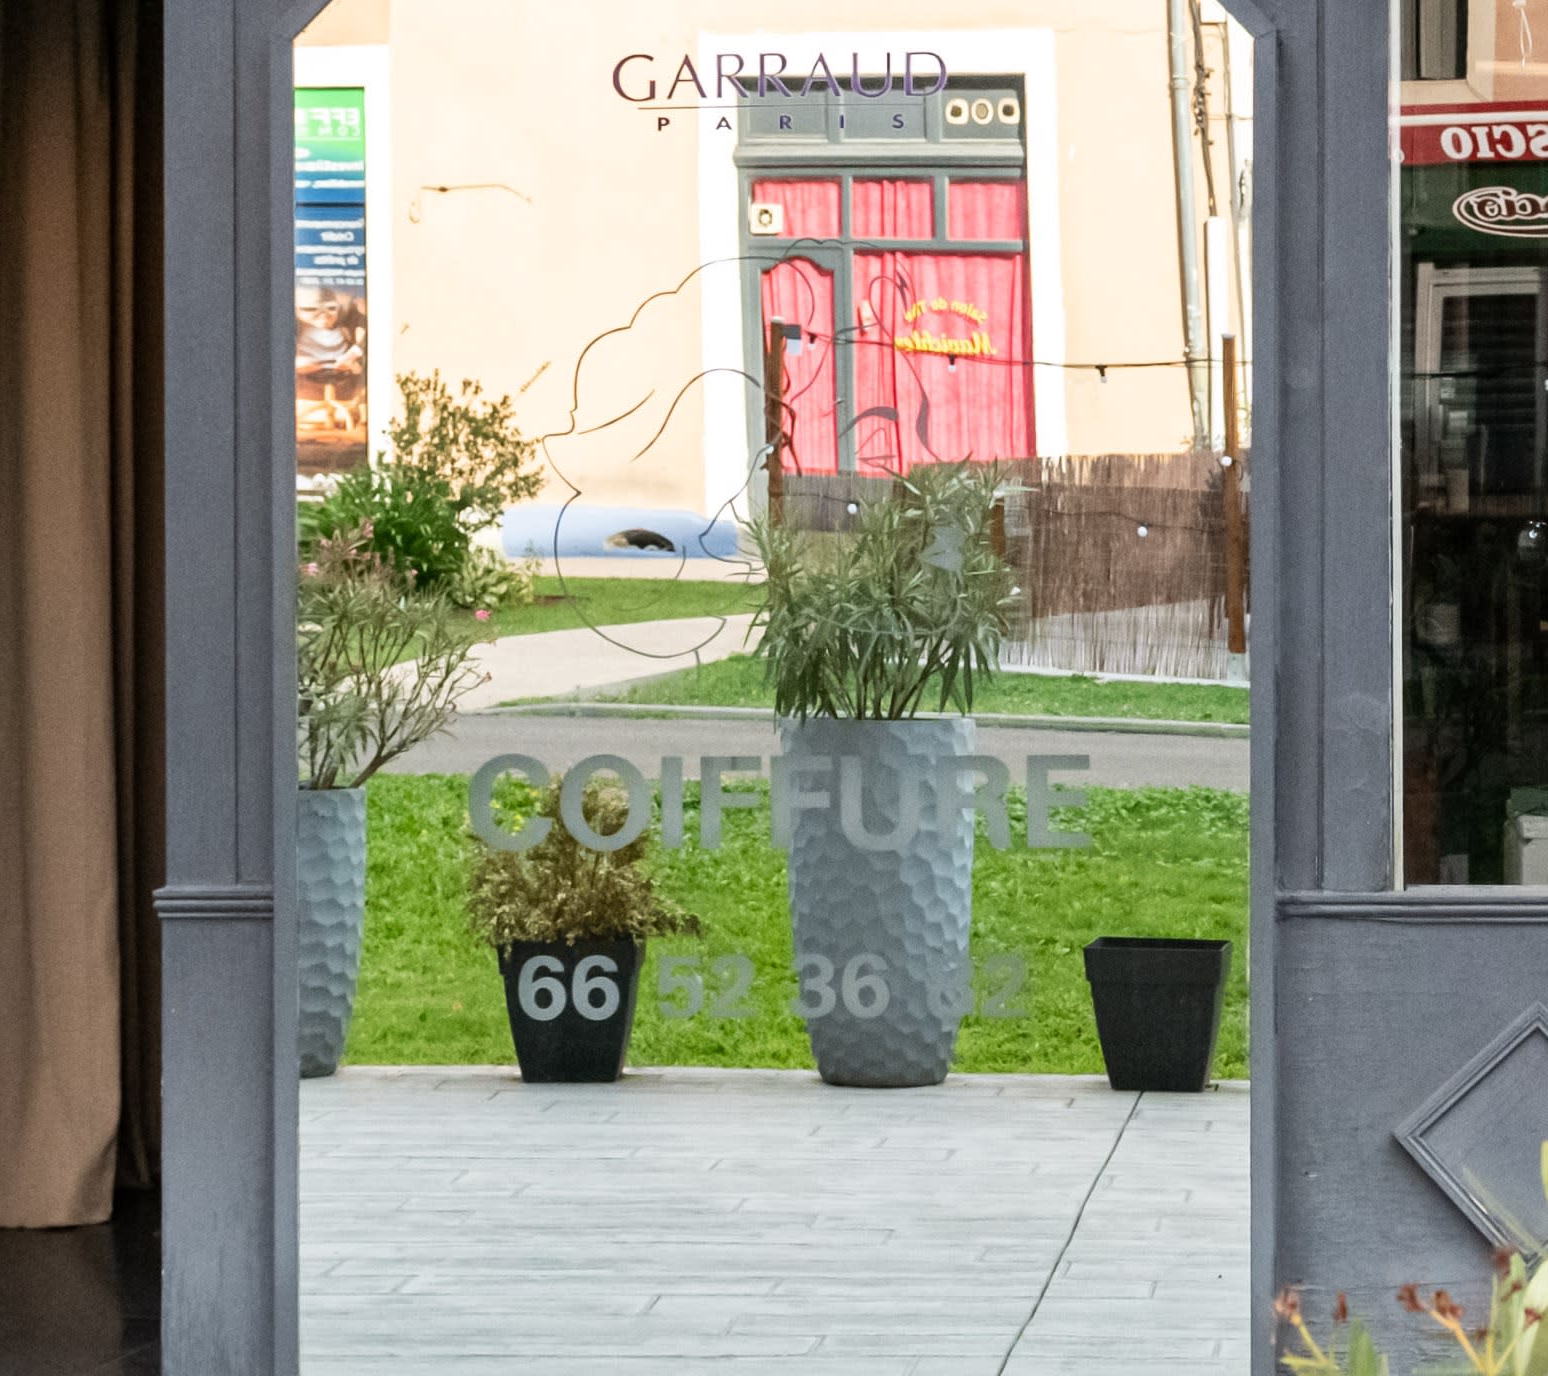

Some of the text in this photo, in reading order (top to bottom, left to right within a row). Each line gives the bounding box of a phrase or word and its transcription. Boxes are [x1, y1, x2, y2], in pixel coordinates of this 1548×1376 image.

[612, 52, 948, 103] GARRAUD
[657, 114, 905, 132] PARIS
[467, 753, 1093, 852] COIFFURE
[517, 955, 621, 1022] 66
[658, 954, 753, 1020] 52
[790, 953, 890, 1020] 36
